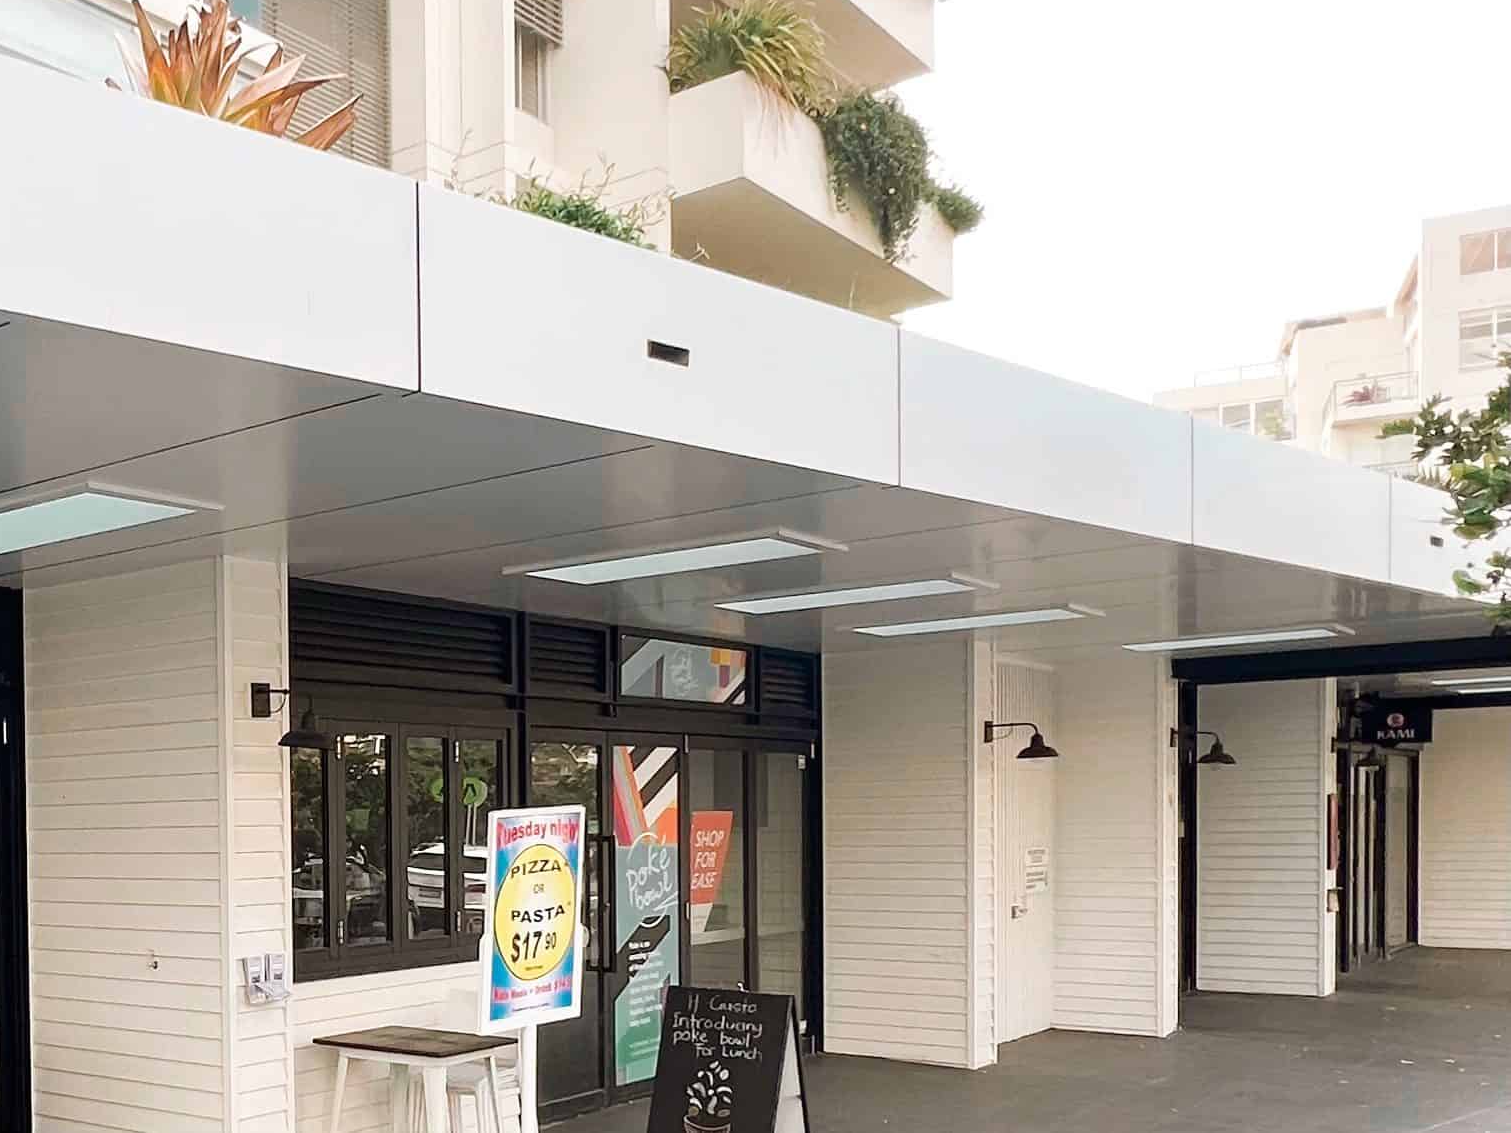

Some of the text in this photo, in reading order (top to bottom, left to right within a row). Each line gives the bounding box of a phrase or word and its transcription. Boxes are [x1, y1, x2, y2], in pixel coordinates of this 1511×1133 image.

[1377, 729, 1415, 739] KAMI
[497, 820, 547, 851] Tuesday
[695, 830, 725, 847] SHOP
[695, 851, 717, 868] FOR
[511, 859, 562, 878] PIZZA
[691, 872, 718, 889] EASE
[635, 871, 672, 910] bowl
[511, 904, 565, 923] PASTA
[720, 1031, 750, 1047] bowl
[722, 1046, 762, 1063] Lunch
